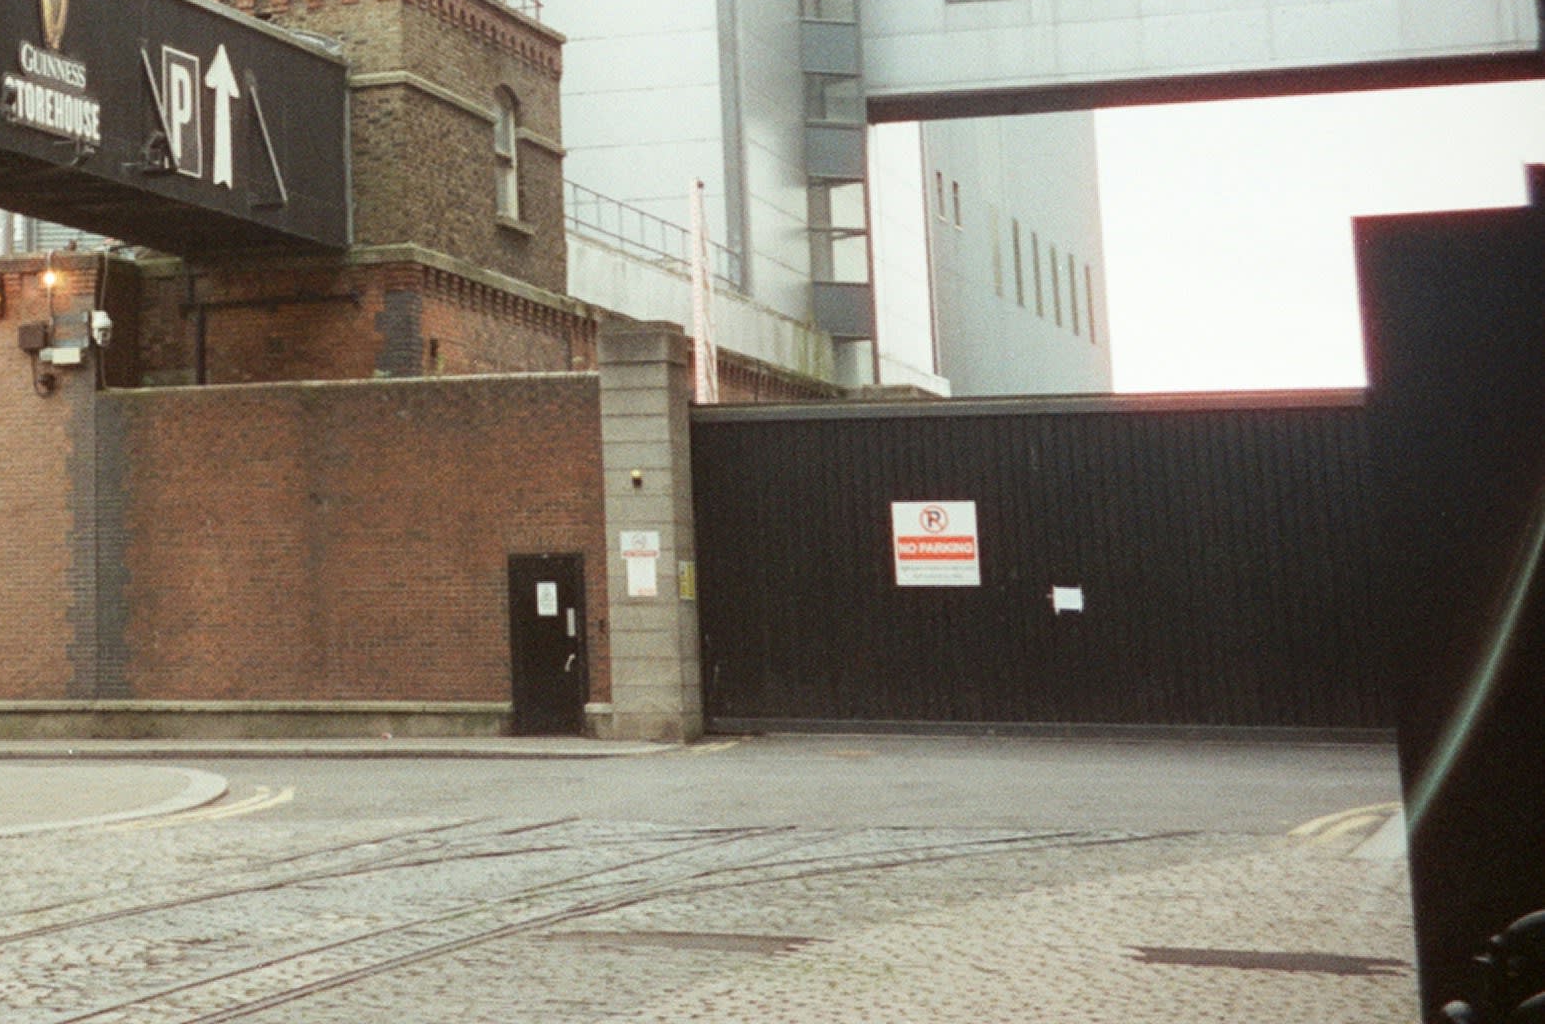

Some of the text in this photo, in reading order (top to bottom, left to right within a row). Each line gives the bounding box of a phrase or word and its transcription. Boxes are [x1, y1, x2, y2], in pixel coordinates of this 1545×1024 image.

[20, 43, 87, 89] GUINNESS
[170, 63, 192, 159] P
[899, 542, 973, 554] NO PARKING
